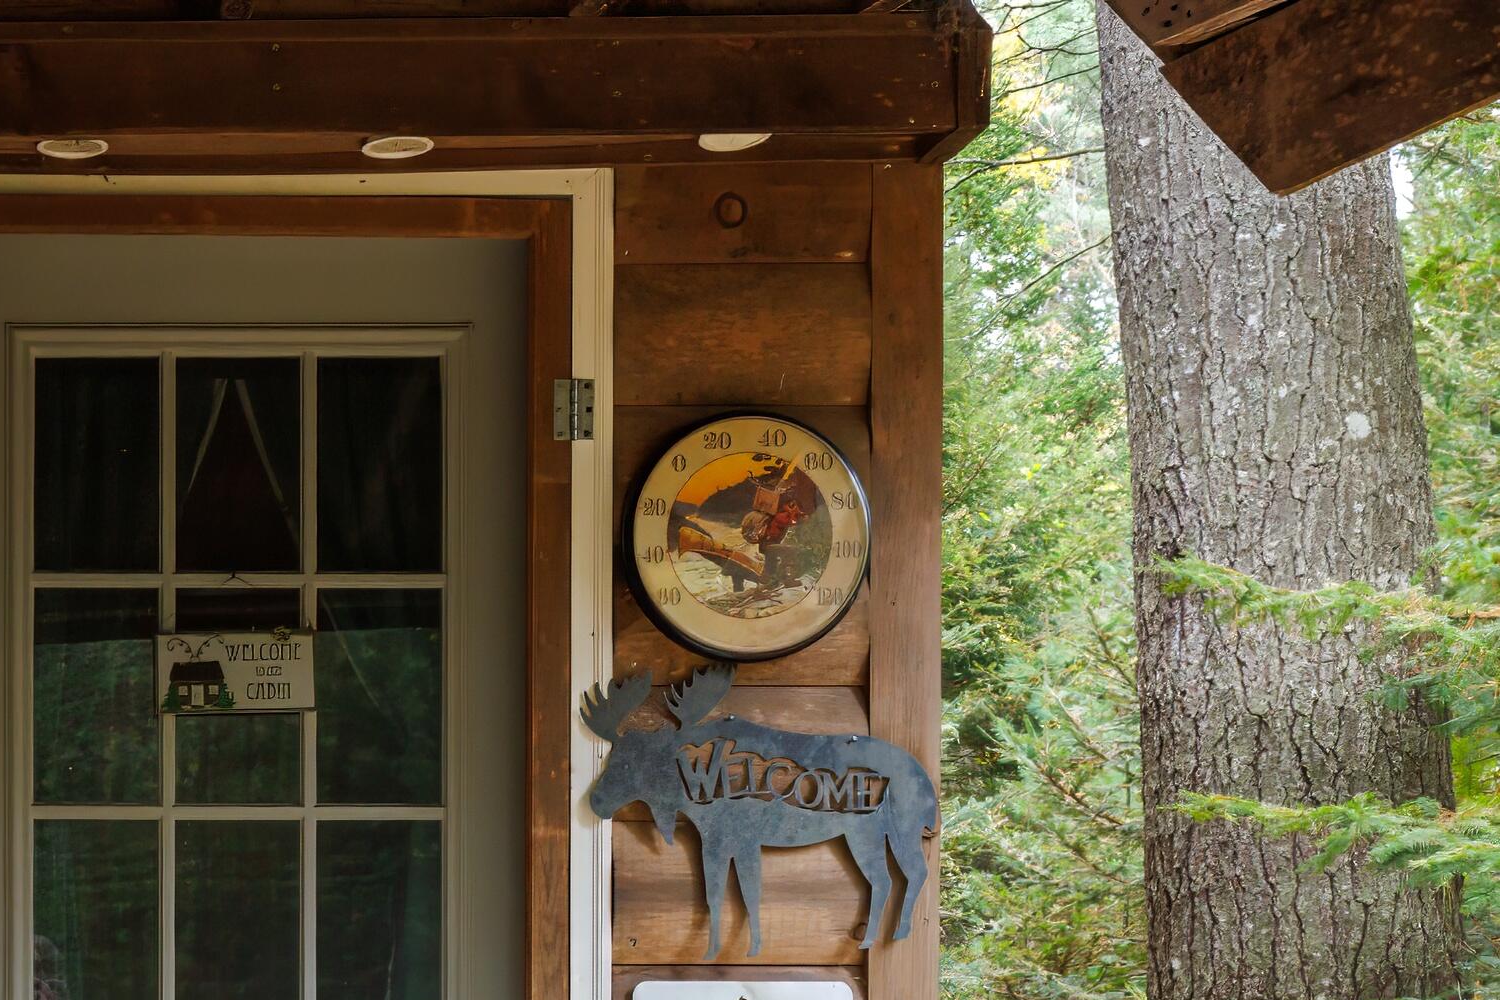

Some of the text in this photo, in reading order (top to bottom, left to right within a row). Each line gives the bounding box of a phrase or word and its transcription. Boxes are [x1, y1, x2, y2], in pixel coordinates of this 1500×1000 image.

[703, 431, 732, 450] 20
[757, 428, 787, 447] 40
[671, 454, 686, 473] 0
[643, 498, 666, 516] 20
[830, 492, 856, 511] 80
[835, 541, 862, 559] 100
[225, 643, 301, 662] WELCOME
[676, 737, 891, 813] WELCOME
